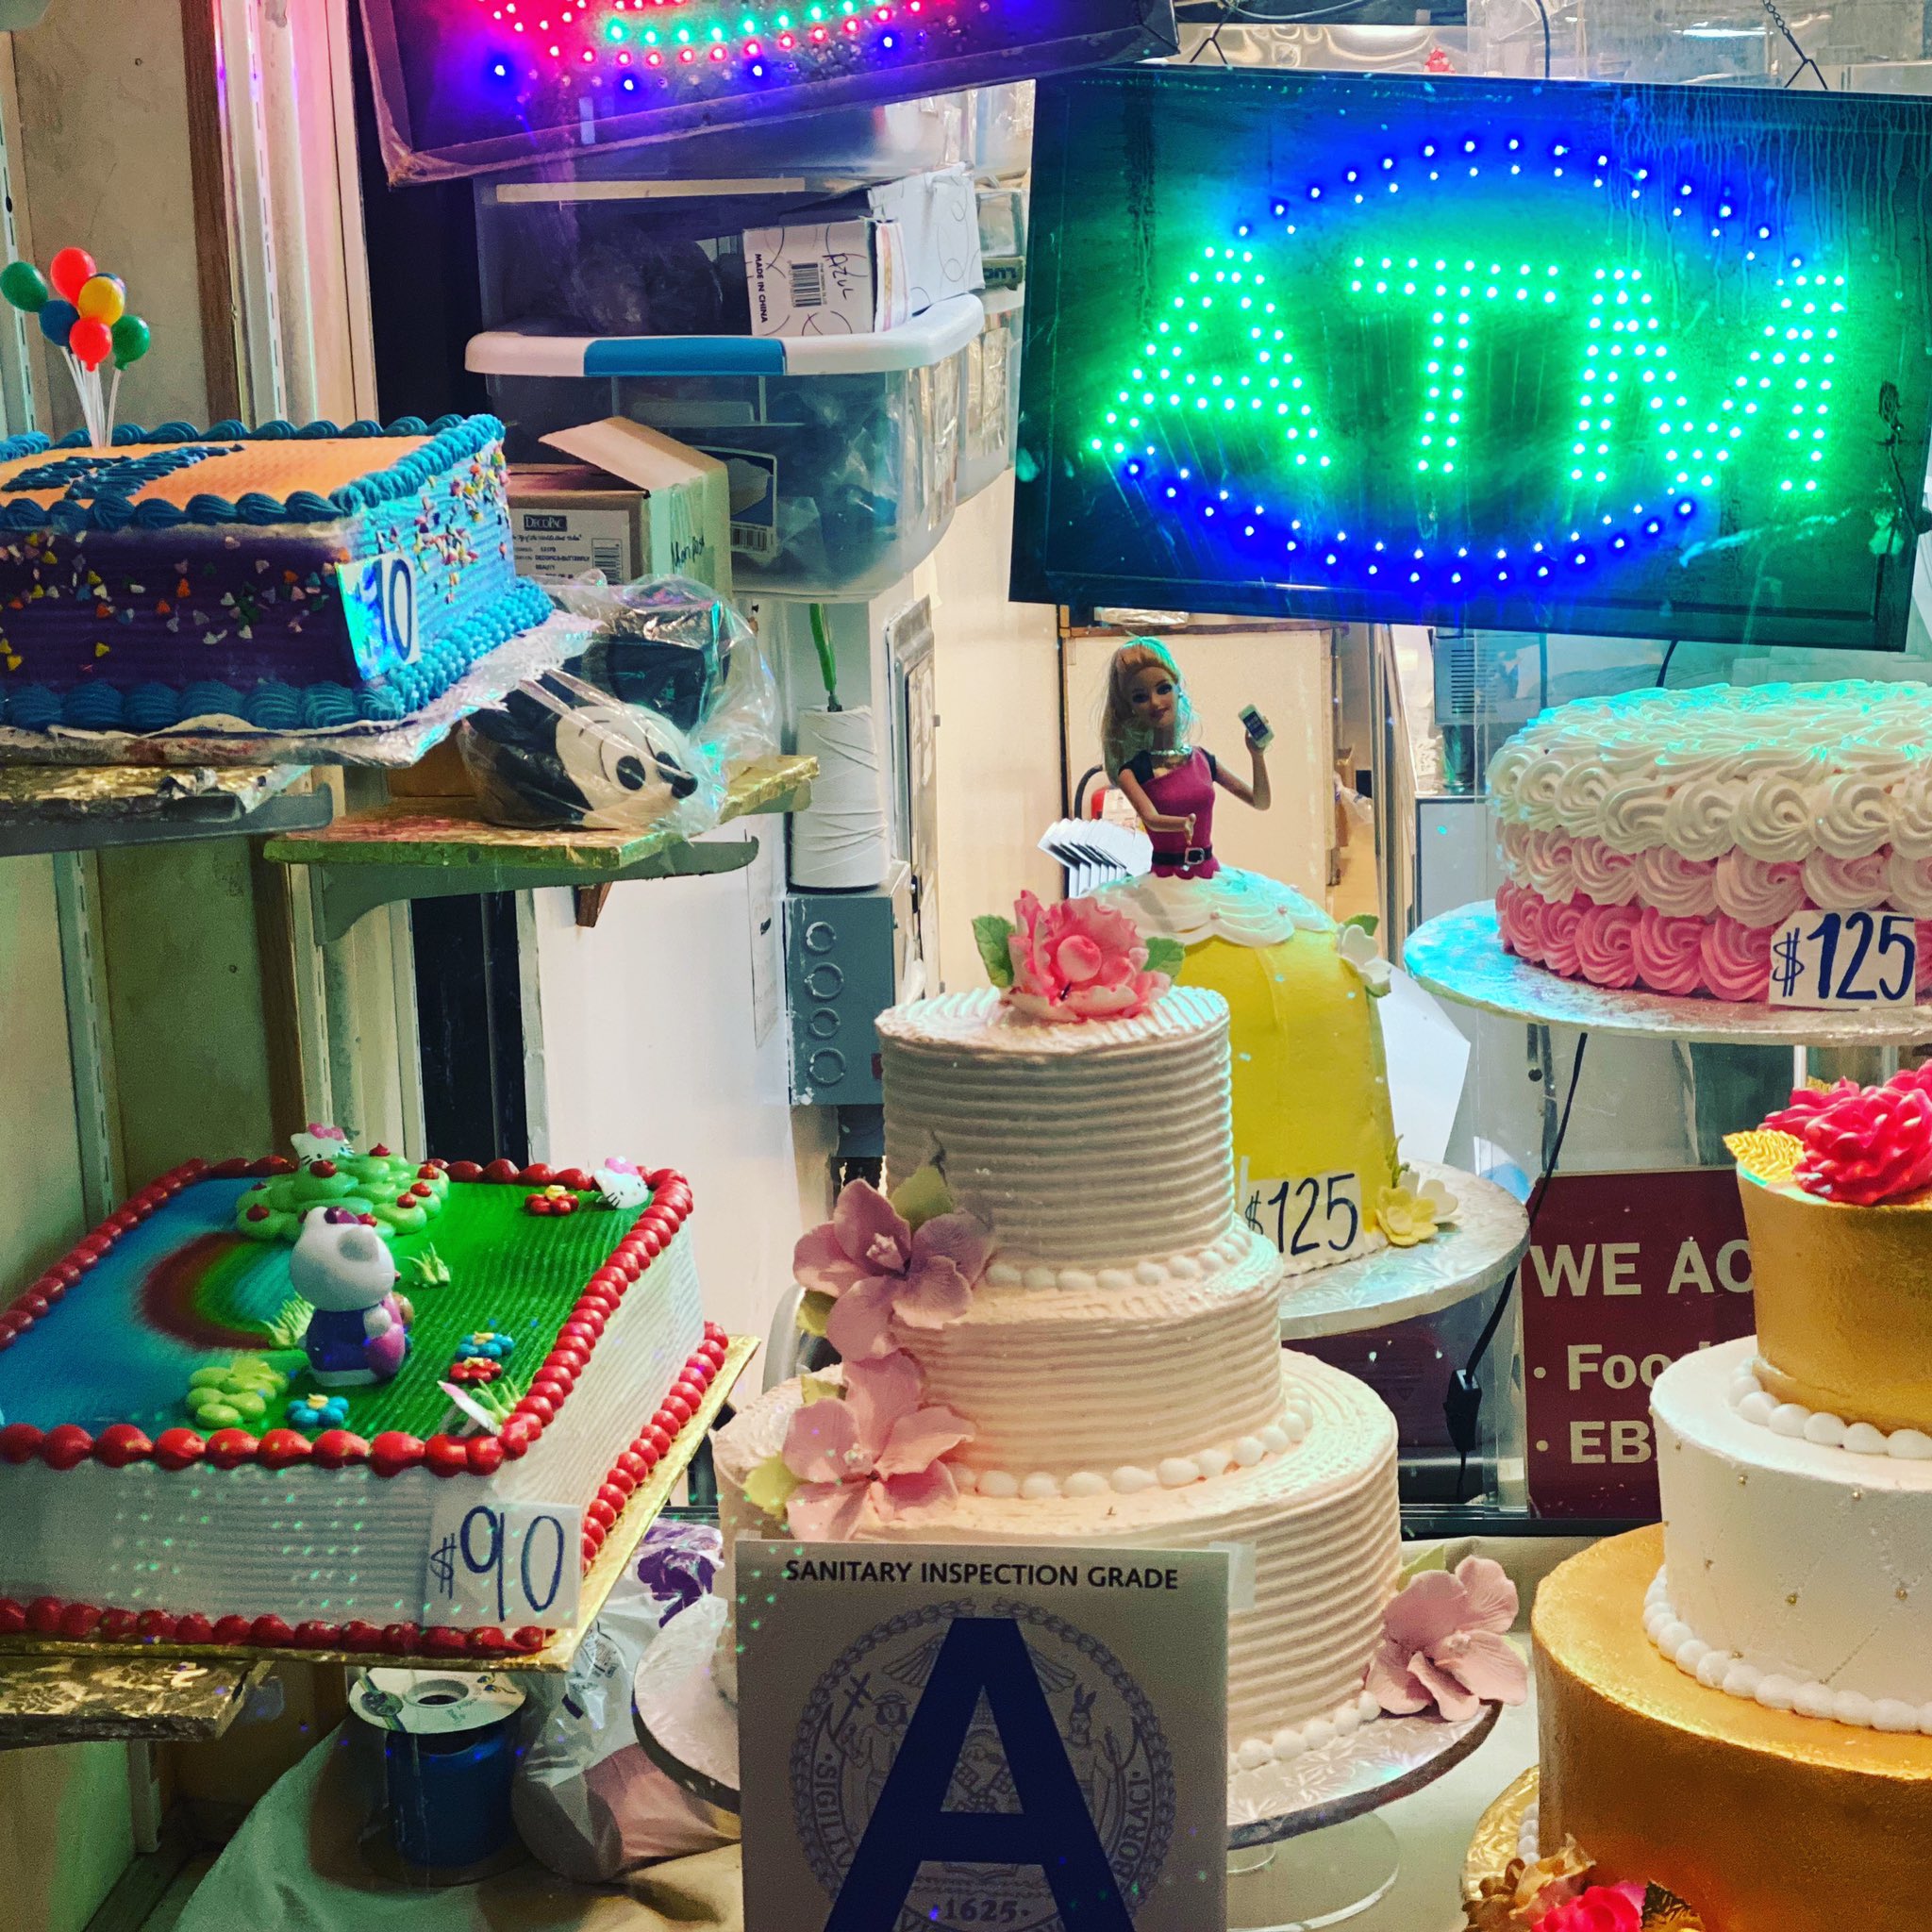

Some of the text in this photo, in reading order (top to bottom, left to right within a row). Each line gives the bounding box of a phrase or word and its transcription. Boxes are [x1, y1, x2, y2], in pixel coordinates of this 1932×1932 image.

[755, 253, 769, 324] MADE IN CHINA
[822, 252, 855, 301] AZUL
[1091, 248, 1845, 492] ATM
[356, 558, 412, 661] 10
[1772, 911, 1916, 1001] $125
[1244, 1173, 1358, 1257] $125
[1529, 1239, 1755, 1297] WE AC
[1567, 1341, 1711, 1391] Foo
[1570, 1420, 1654, 1464] EB
[429, 1505, 565, 1623] $90
[785, 1558, 1179, 1591] SANITARY INSPECTION GRADE
[814, 1763, 854, 1869] SIGILLU
[823, 1617, 1136, 1932] A
[1110, 1777, 1151, 1881] BORACI
[944, 1897, 1019, 1924] 1625
